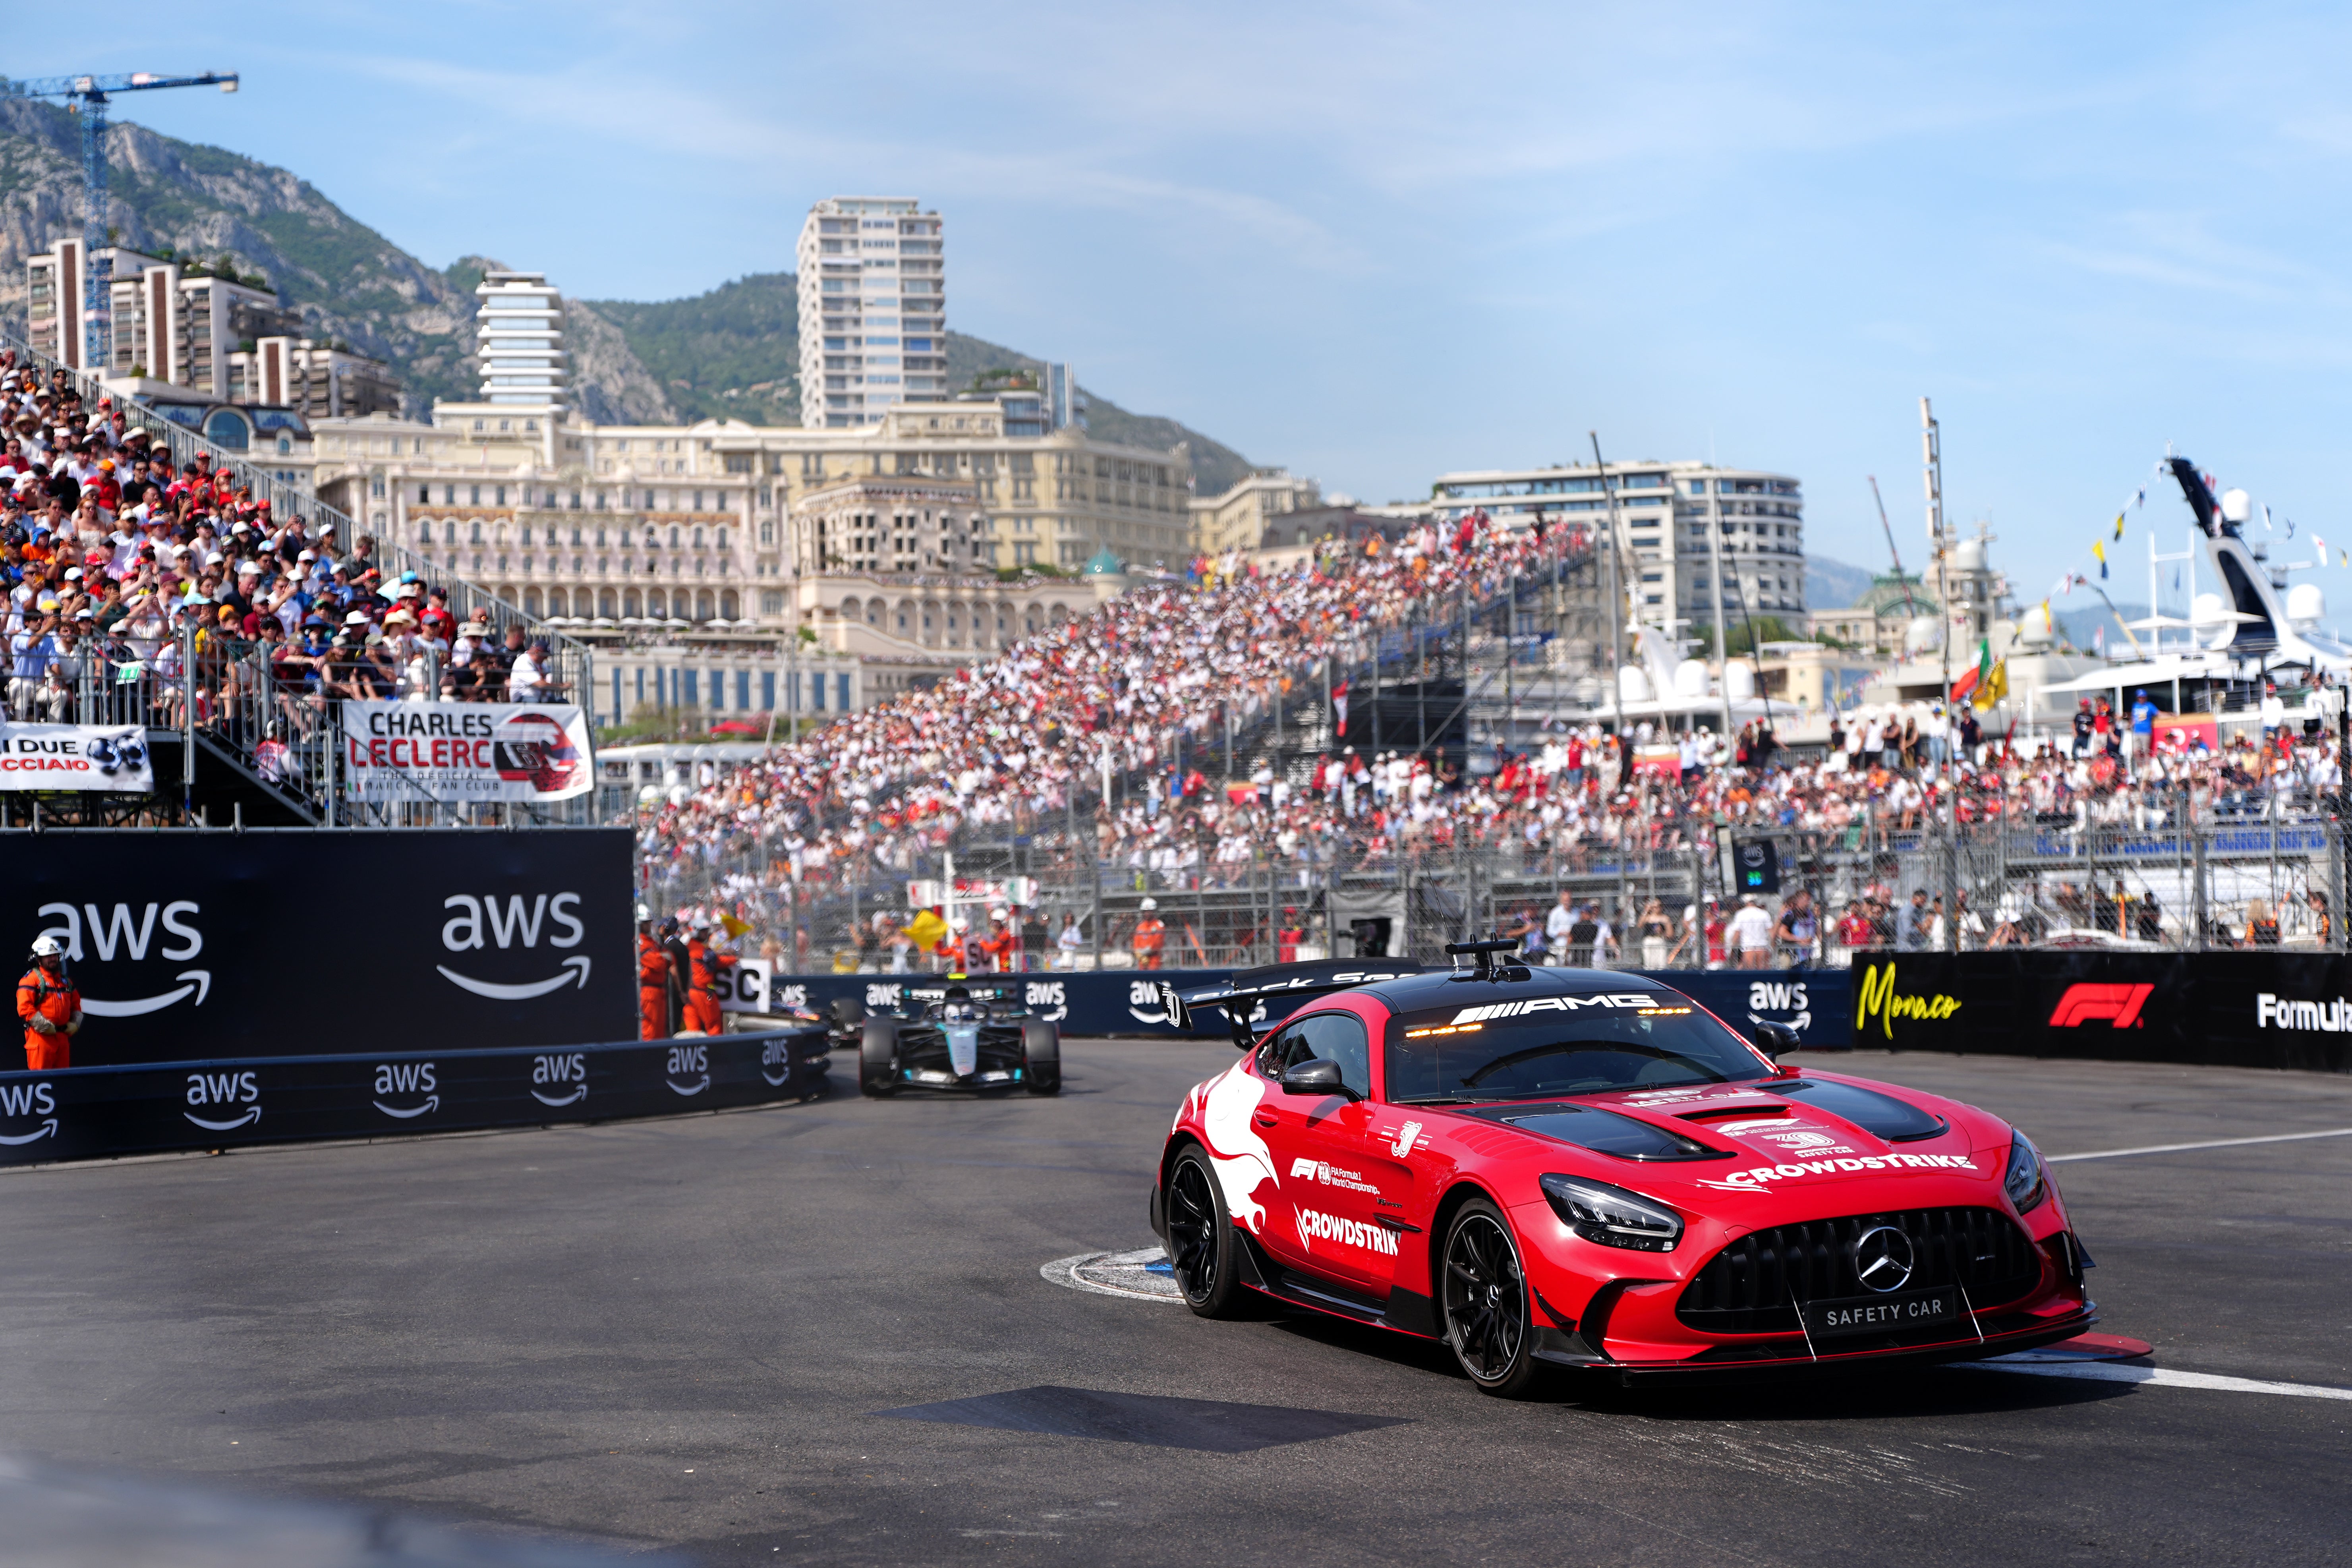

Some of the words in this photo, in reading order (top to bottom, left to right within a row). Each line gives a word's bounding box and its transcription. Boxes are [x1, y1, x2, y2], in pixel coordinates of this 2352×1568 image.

[369, 711, 493, 737] CHARLES
[17, 739, 79, 754] DUE
[349, 737, 491, 768] LECLERC
[0, 758, 90, 771] CCIAIO
[382, 771, 407, 780] THE
[432, 781, 462, 791] FAN
[466, 781, 499, 791] CLUB
[37, 901, 203, 961] aws
[442, 892, 586, 952] aws
[715, 968, 760, 1002] SC
[777, 984, 807, 1006] ws
[866, 983, 901, 1006] aws
[1025, 981, 1065, 1005] aws
[1749, 982, 1809, 1011] aws
[1517, 994, 1660, 1015] AMG
[1856, 961, 1962, 1040] Monaco
[2049, 983, 2156, 1029] F1
[667, 1044, 709, 1074] aws
[762, 1038, 789, 1065] aws
[375, 1062, 437, 1093] aws
[533, 1053, 586, 1084] aws
[0, 1083, 55, 1116] ws
[187, 1071, 259, 1106] aws
[1621, 1095, 1704, 1106] SAFETY
[1716, 1118, 1801, 1133] F1
[1761, 1132, 1836, 1149] 30
[1290, 1158, 1319, 1181] F1
[1339, 1168, 1358, 1180] Formula
[1358, 1172, 1362, 1181] 1
[1725, 1154, 1978, 1185] CROWDSTRIKE
[1332, 1177, 1345, 1187] World
[1345, 1179, 1377, 1195] Championship
[1303, 1208, 1402, 1256] CROWDSTRIK
[1827, 1305, 1900, 1326] SAFETY
[1909, 1299, 1942, 1317] CAR
